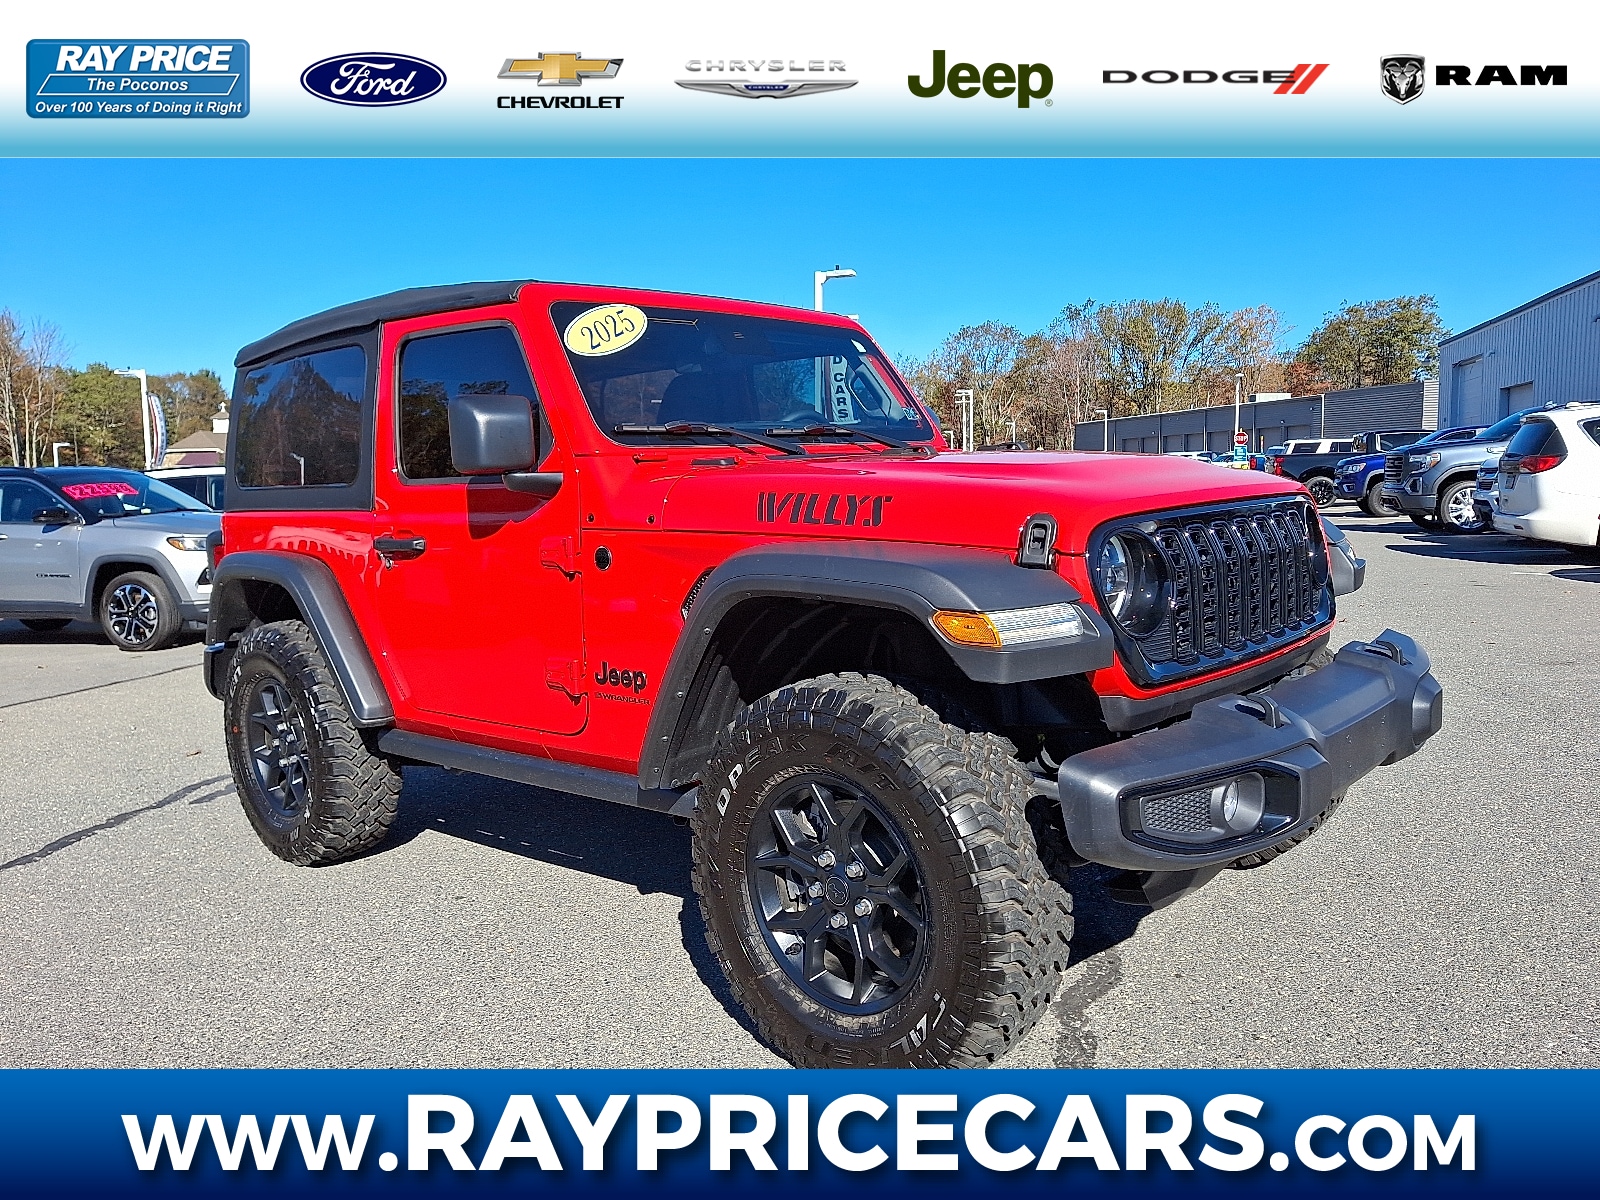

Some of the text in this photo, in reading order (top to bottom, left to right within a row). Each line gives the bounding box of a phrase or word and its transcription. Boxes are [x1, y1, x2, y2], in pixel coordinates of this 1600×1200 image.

[580, 309, 636, 351] 2025
[832, 372, 850, 419] CARS
[757, 491, 894, 528] WILLYS
[594, 660, 647, 694] Jeep
[602, 693, 651, 705] WRANGLER
